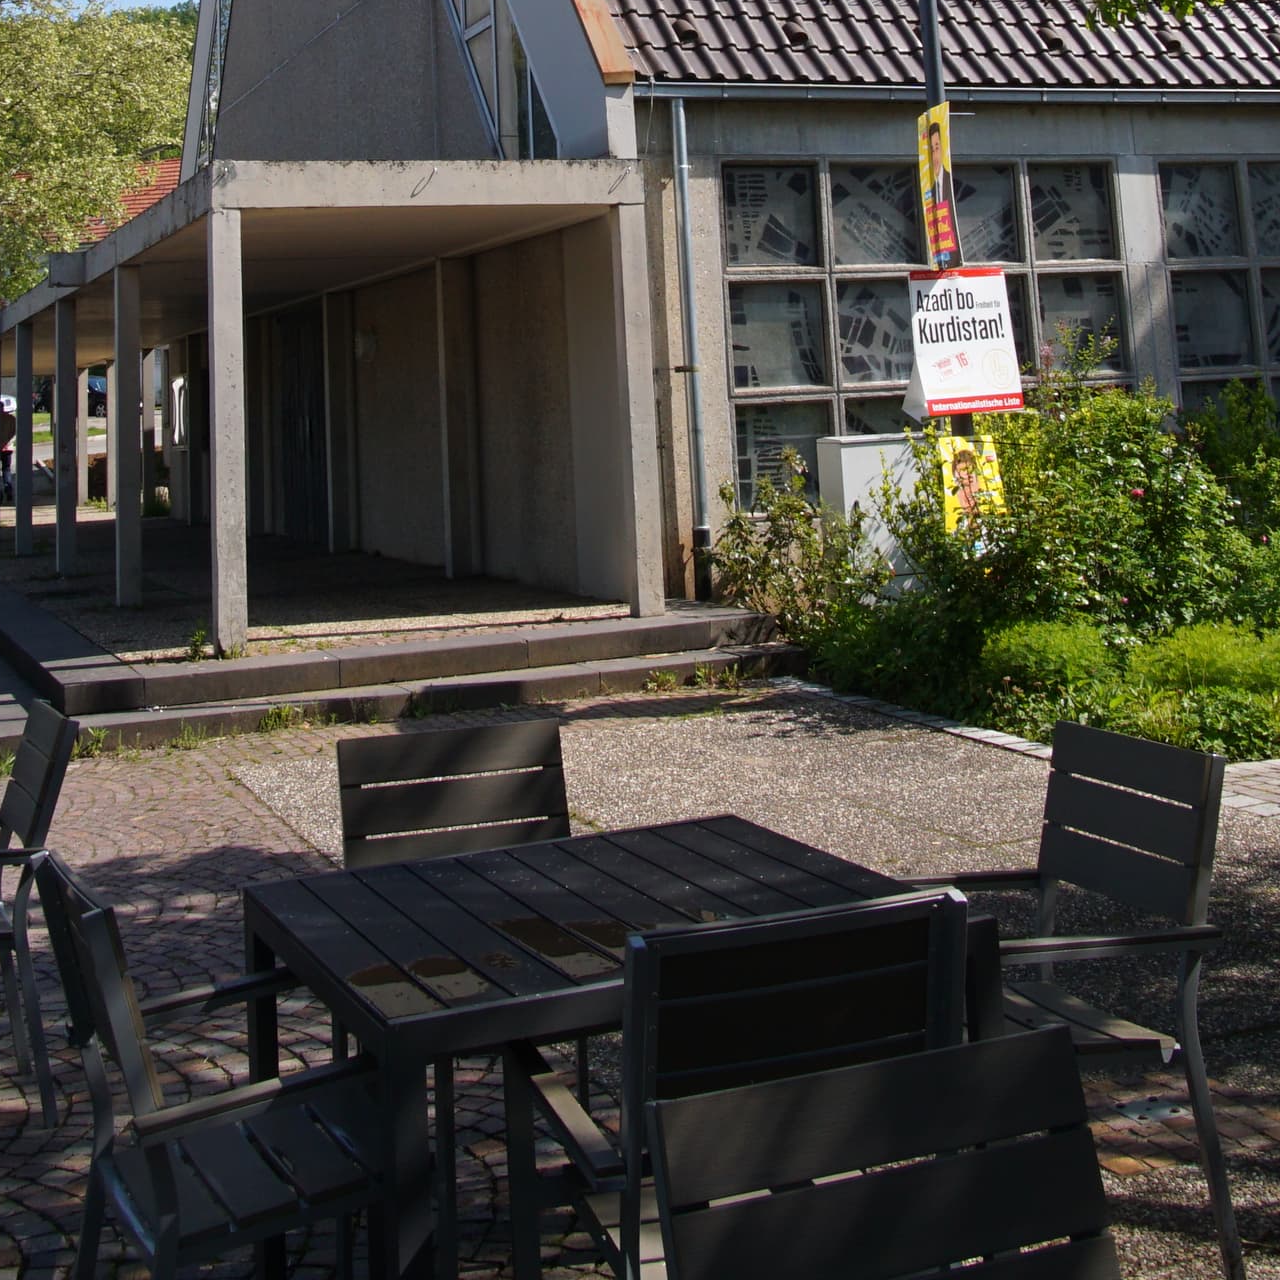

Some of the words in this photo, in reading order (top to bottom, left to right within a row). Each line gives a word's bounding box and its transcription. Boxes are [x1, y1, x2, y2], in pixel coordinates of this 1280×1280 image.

[916, 288, 953, 313] Azadî
[955, 288, 975, 310] bo
[918, 313, 1005, 344] Kurdistan!
[955, 351, 969, 368] 16
[932, 399, 1004, 412] Internationalistische
[1004, 398, 1021, 407] Liste
